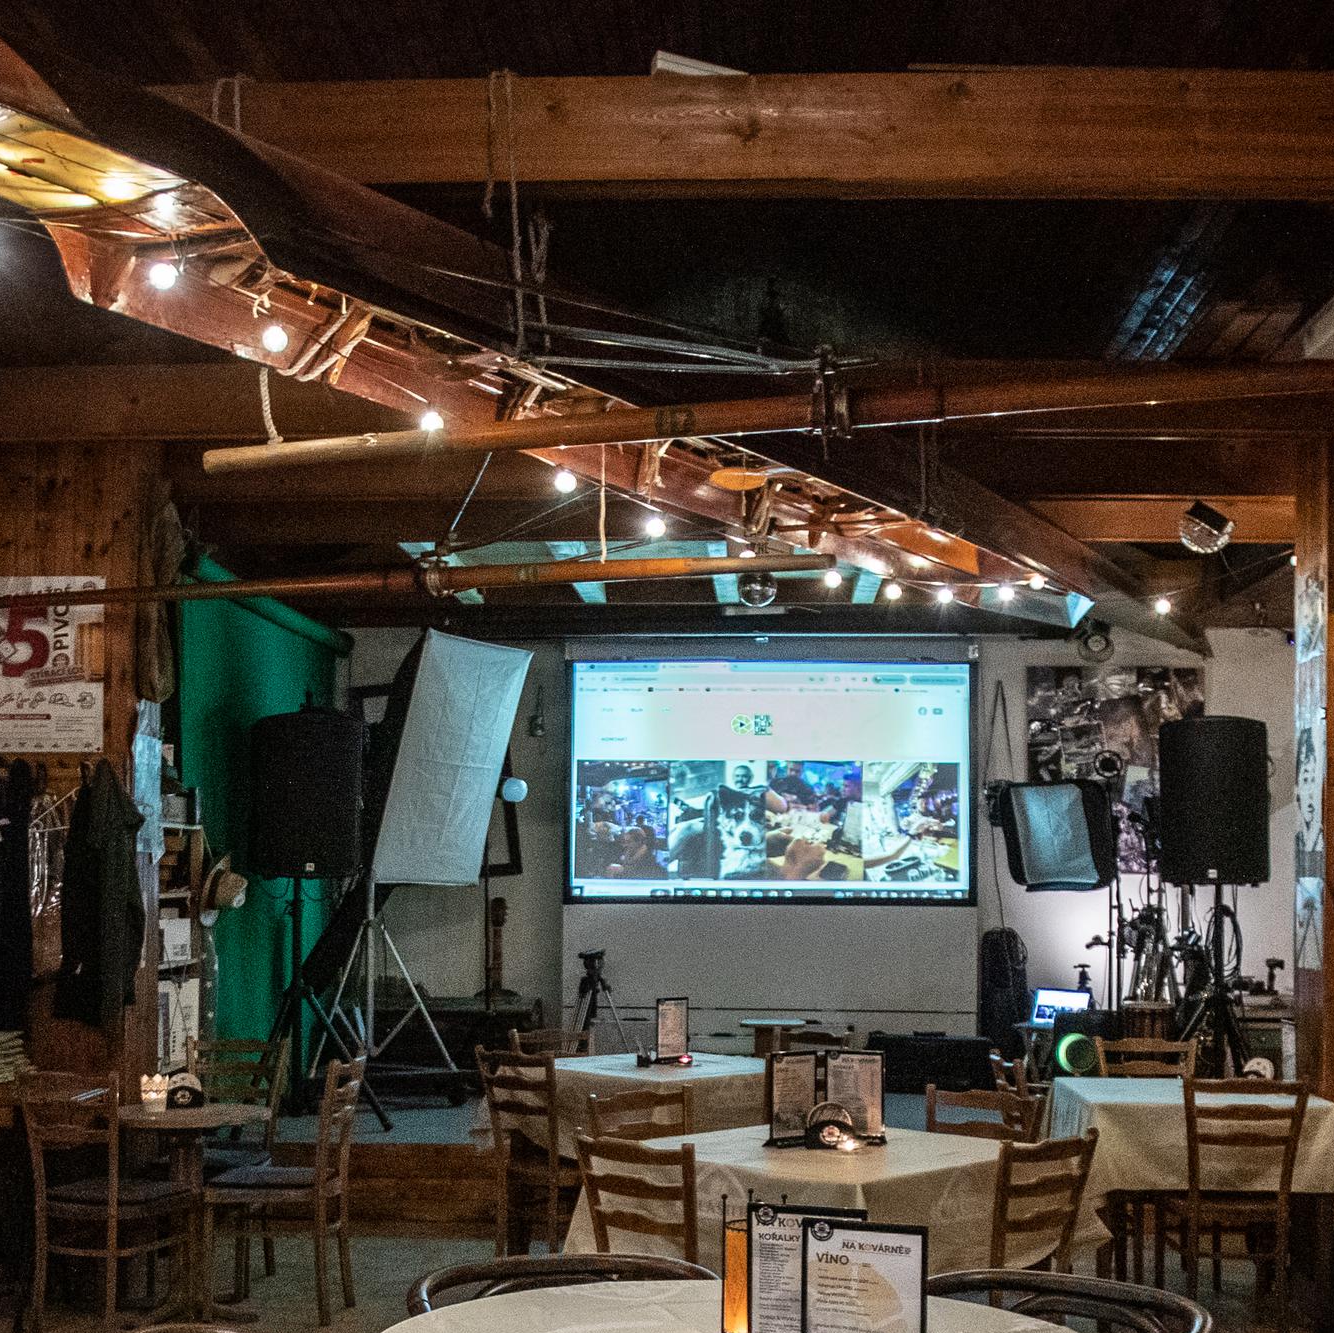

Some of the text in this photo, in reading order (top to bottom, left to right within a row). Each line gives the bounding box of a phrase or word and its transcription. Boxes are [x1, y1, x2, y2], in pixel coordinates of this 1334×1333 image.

[757, 1231, 801, 1243] KOŘALKY
[842, 1240, 857, 1251] NA
[816, 1252, 850, 1266] VÍNO
